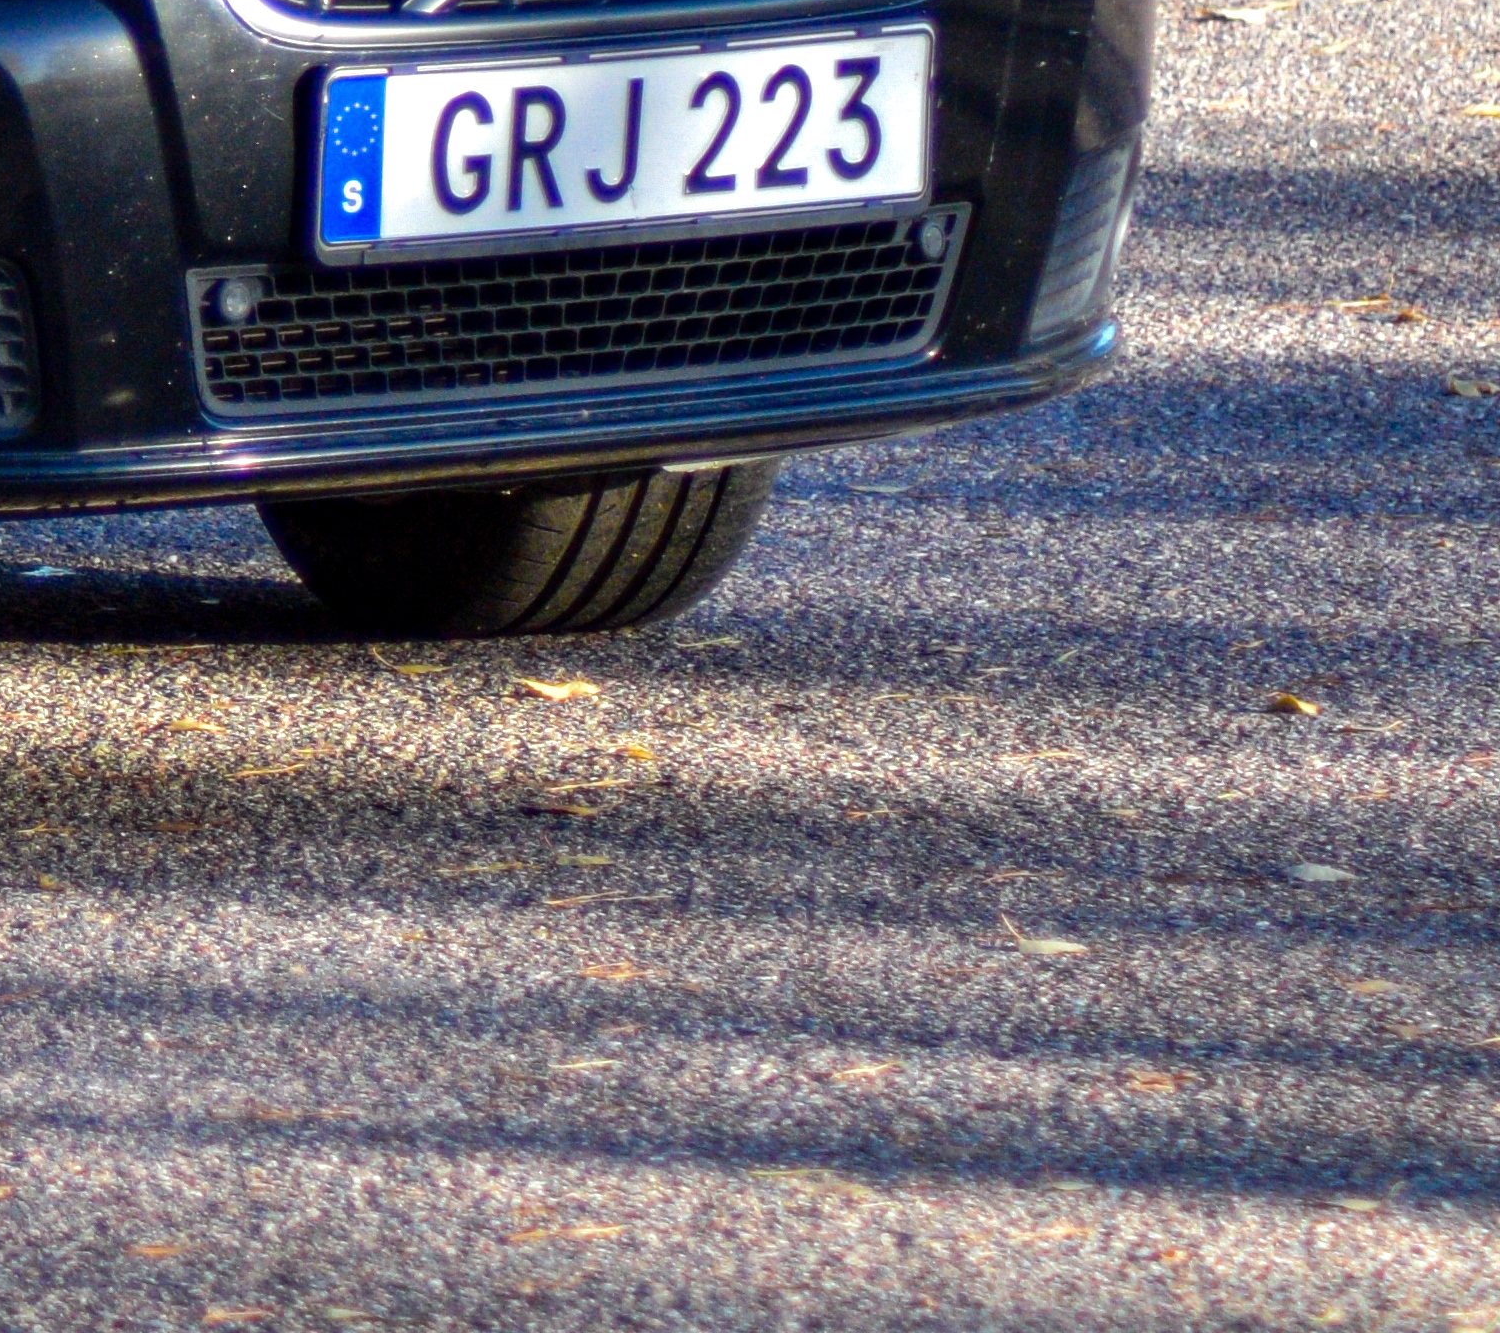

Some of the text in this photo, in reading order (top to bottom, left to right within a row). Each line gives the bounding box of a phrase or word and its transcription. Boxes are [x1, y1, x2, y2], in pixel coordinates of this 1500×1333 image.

[430, 55, 882, 215] GRJ 223
[342, 179, 362, 213] S
